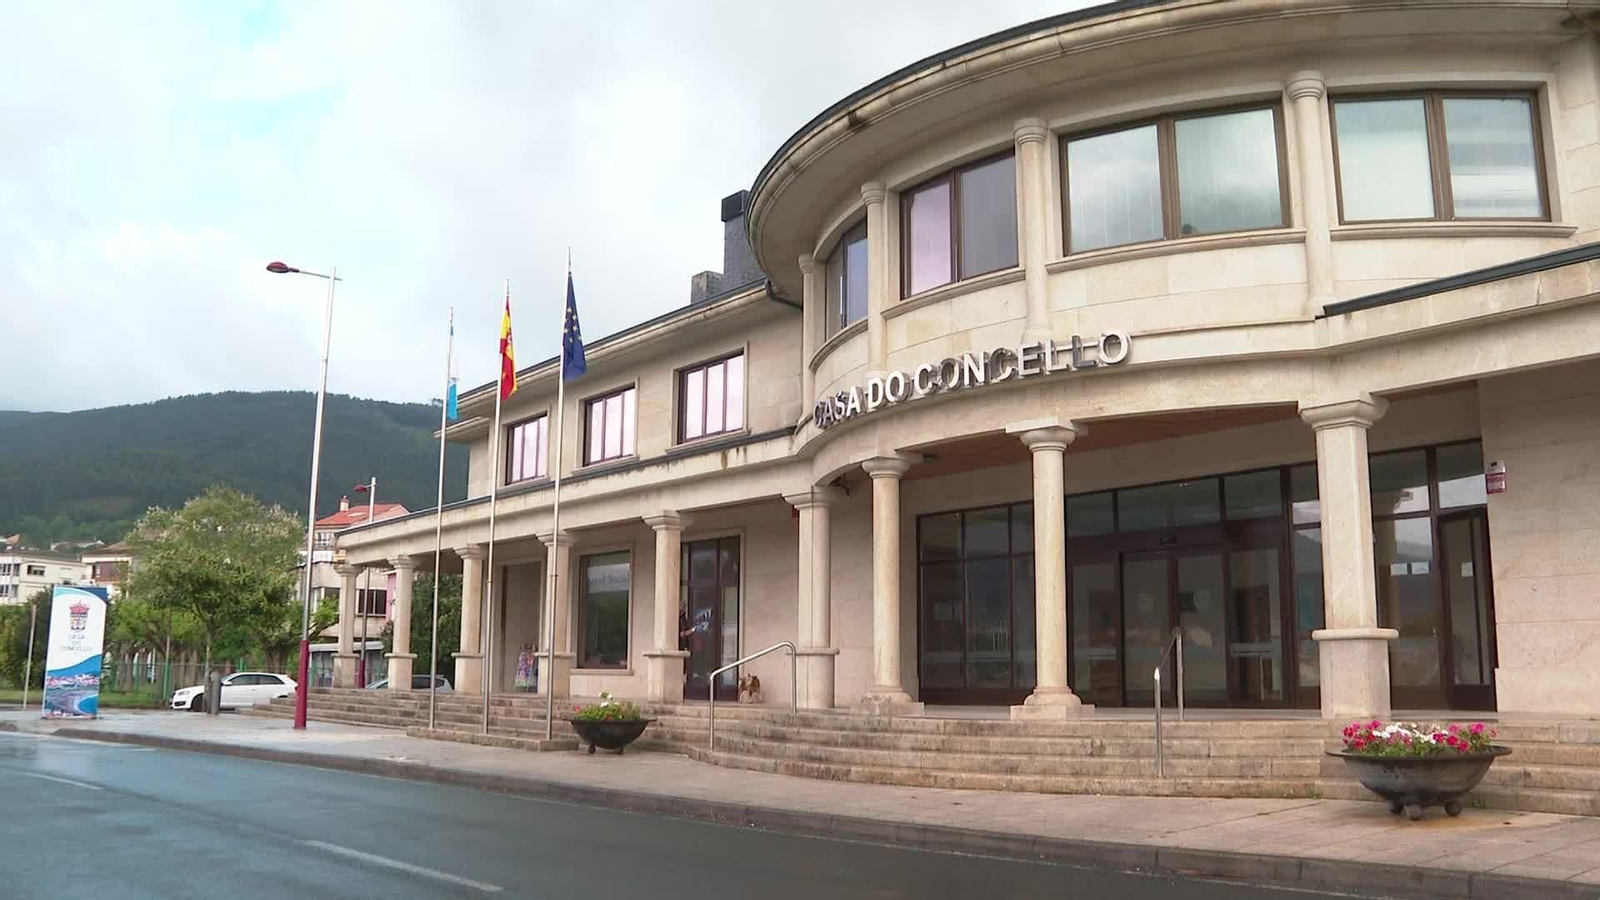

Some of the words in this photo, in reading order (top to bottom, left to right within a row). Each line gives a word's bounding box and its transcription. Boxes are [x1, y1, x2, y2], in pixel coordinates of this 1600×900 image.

[813, 386, 864, 428] CASA
[868, 371, 909, 410] DO
[914, 331, 1132, 395] CONCELLO
